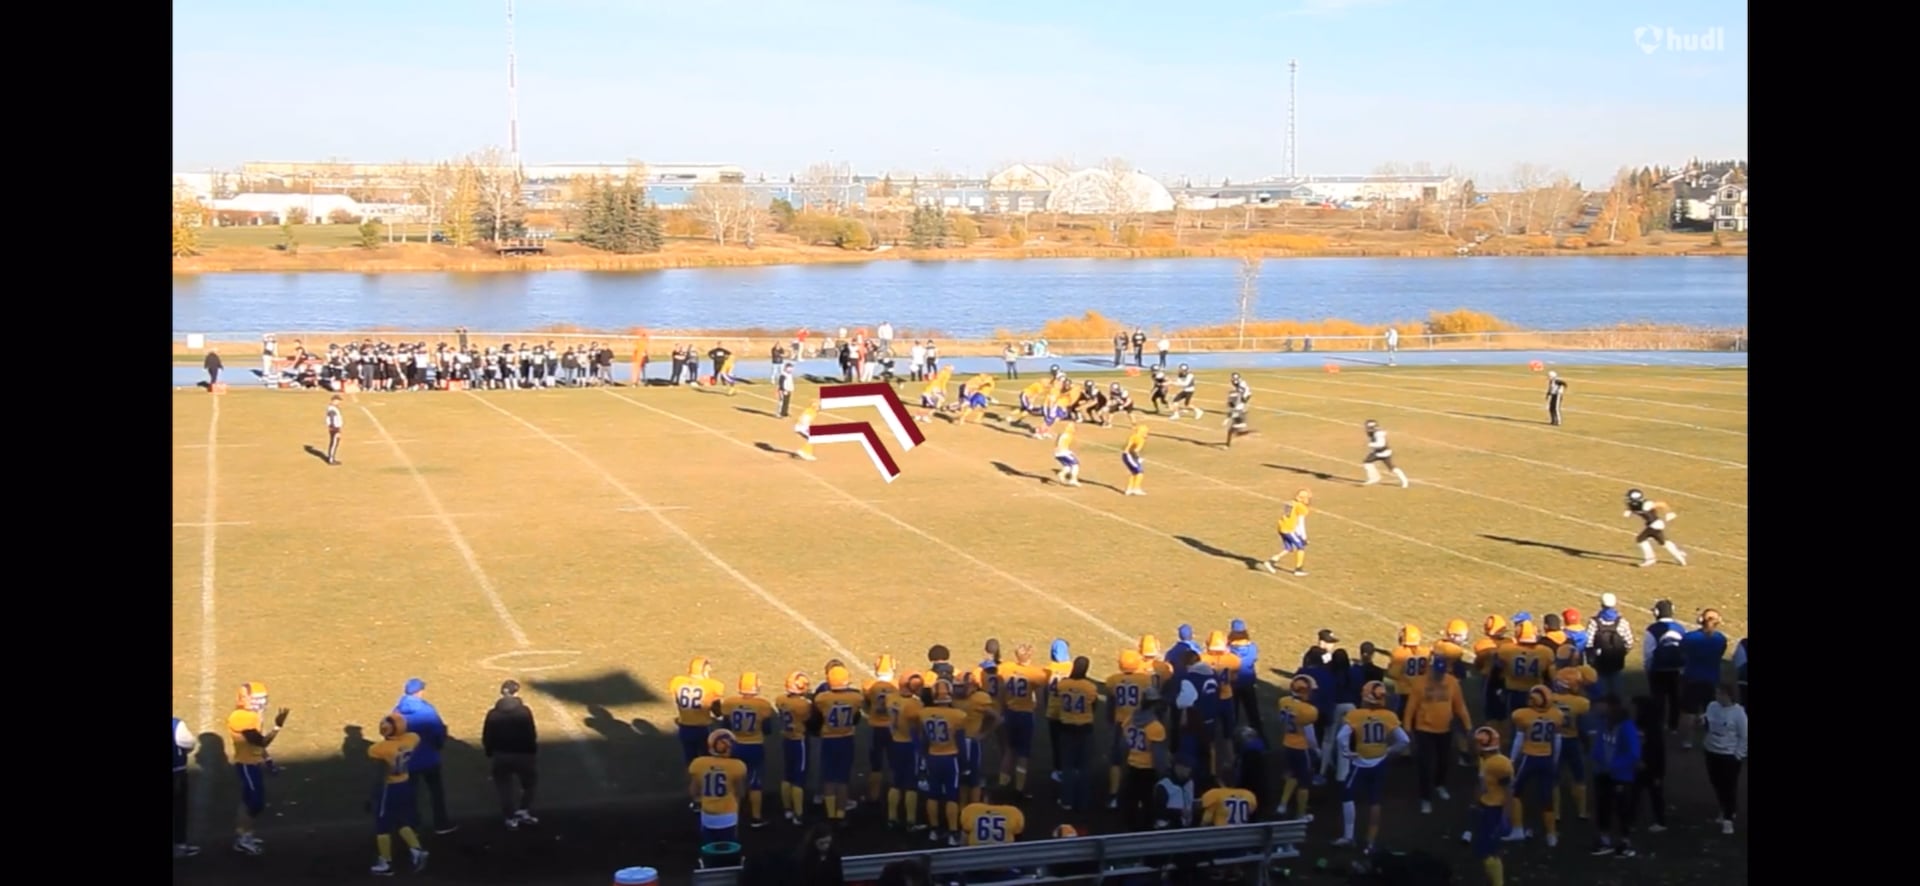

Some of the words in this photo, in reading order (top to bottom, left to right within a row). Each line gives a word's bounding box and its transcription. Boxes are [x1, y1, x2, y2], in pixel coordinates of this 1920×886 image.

[1513, 657, 1540, 678] 64
[678, 687, 703, 709] 62
[1006, 677, 1028, 698] 42
[1115, 685, 1139, 707] 89
[1062, 693, 1086, 714] 34
[731, 711, 757, 732] 87
[827, 707, 853, 728] 47
[924, 720, 949, 743] 83
[1126, 726, 1147, 751] 33
[1361, 722, 1385, 744] 10
[1531, 720, 1556, 743] 28
[703, 772, 727, 798] 16
[1223, 800, 1249, 824] 70
[976, 816, 1006, 842] 65
